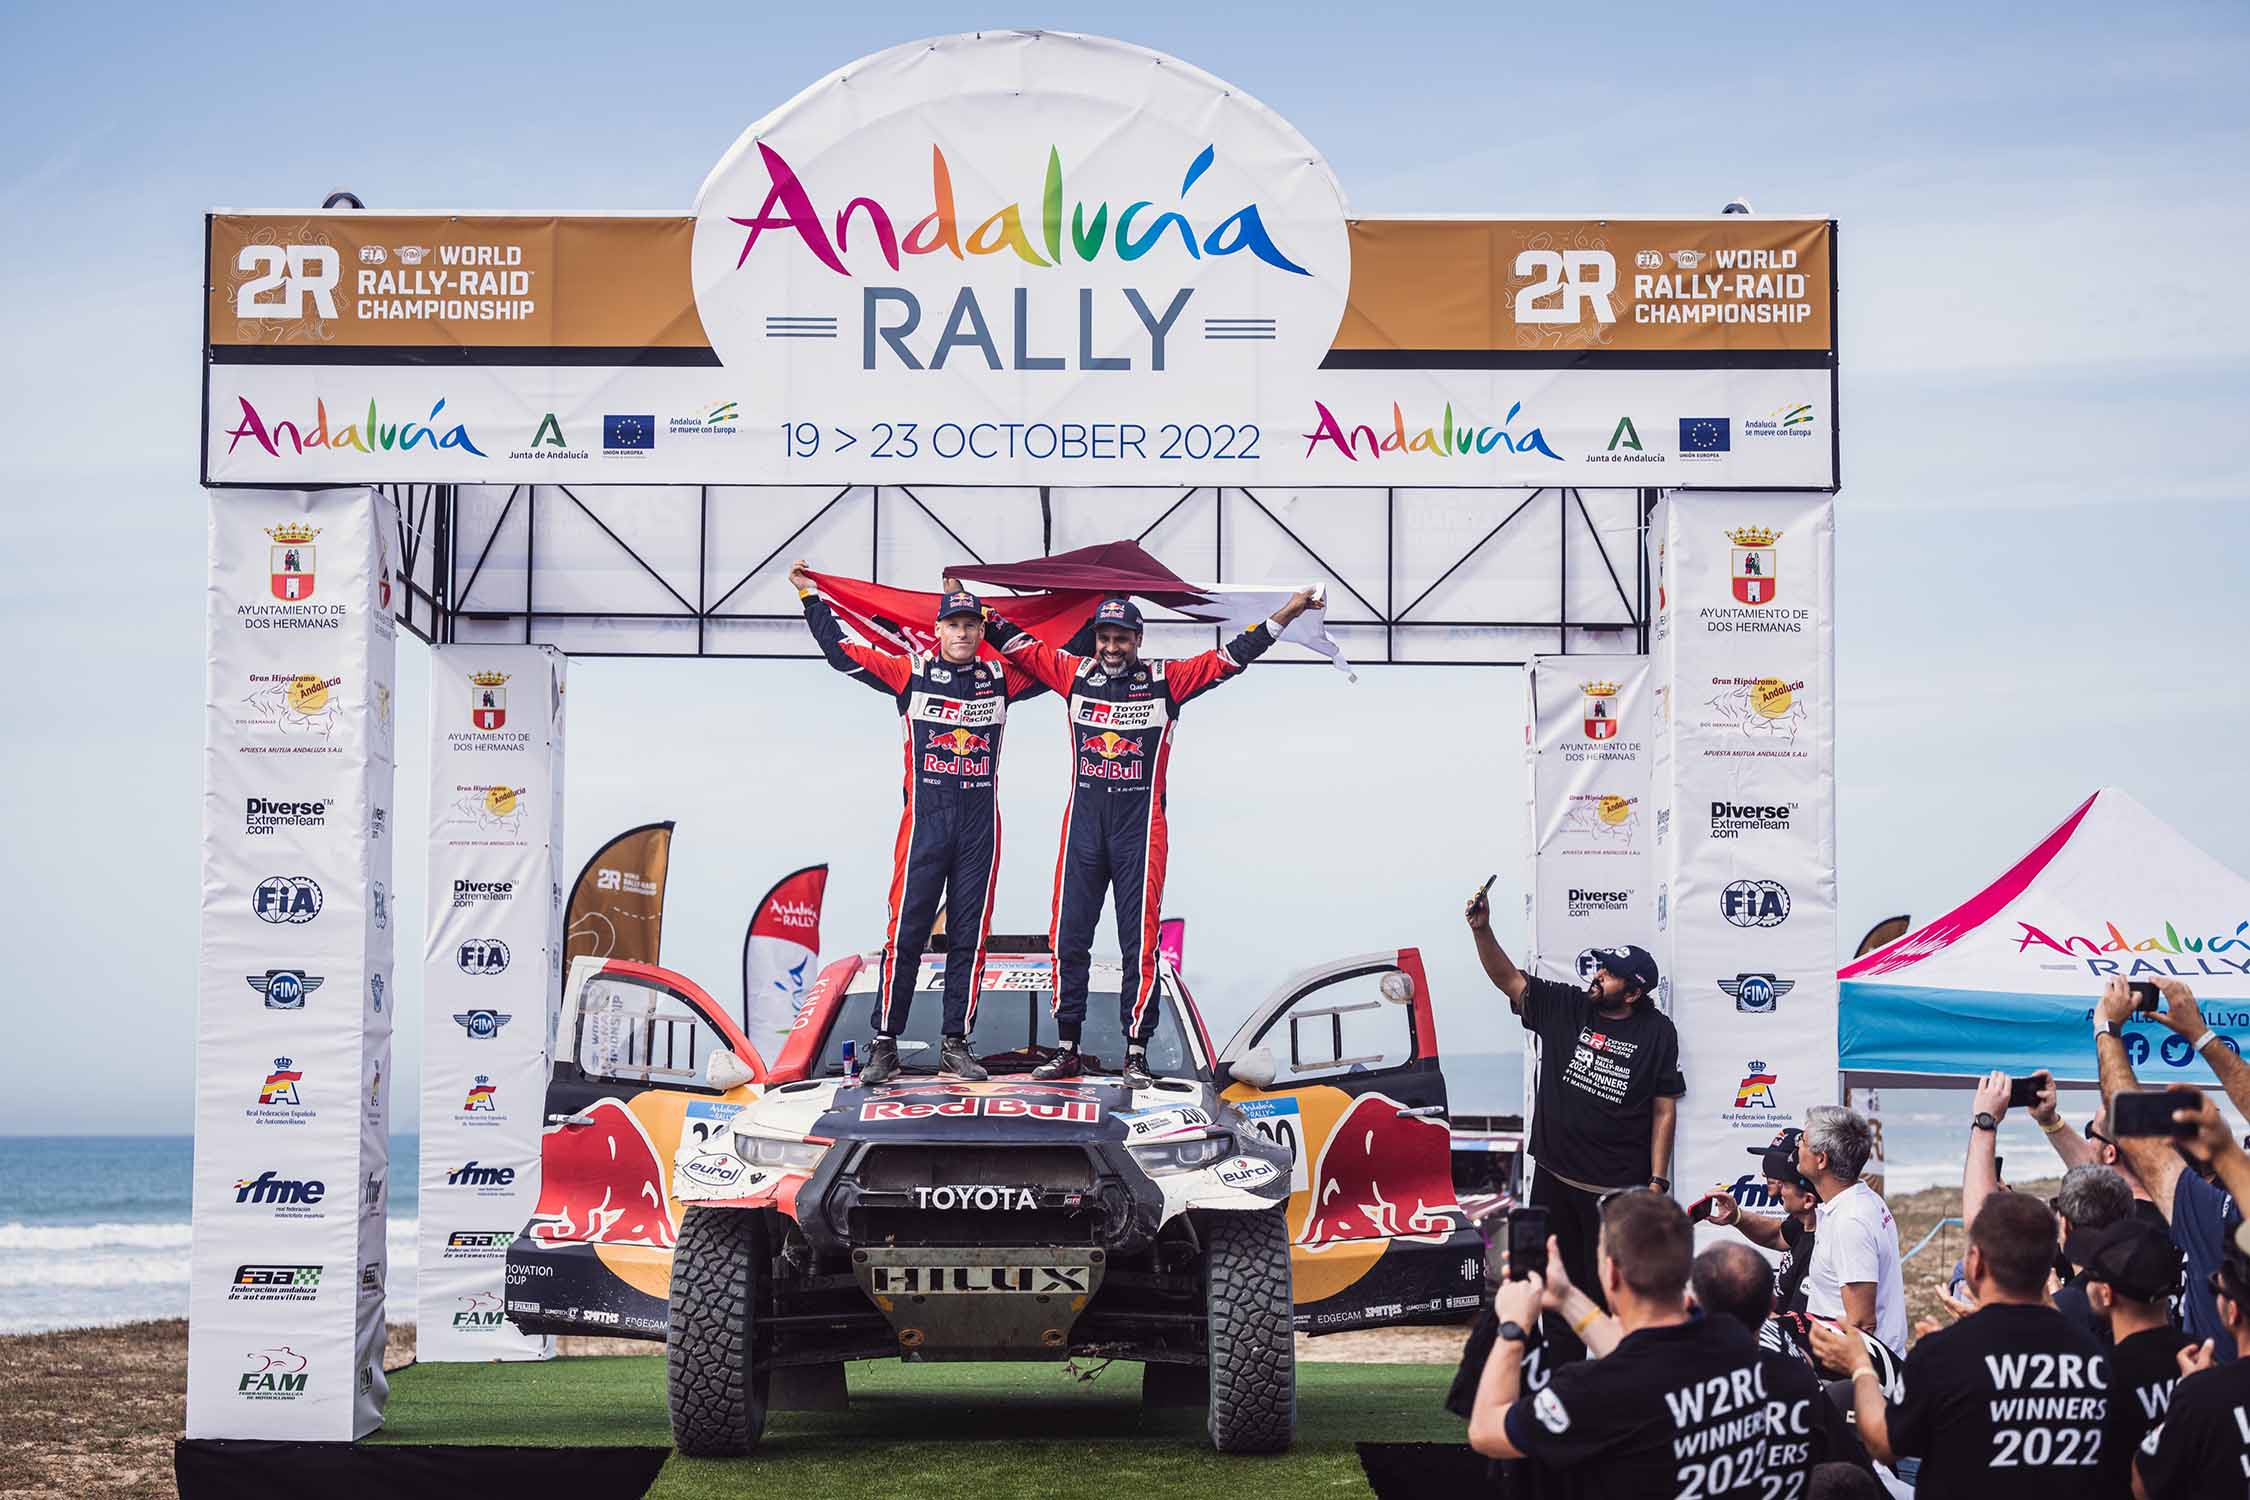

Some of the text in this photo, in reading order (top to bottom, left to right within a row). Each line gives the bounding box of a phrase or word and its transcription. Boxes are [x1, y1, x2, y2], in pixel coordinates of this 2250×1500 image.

[727, 140, 1315, 277] Andalucía
[440, 246, 522, 265] WORLD
[1715, 249, 1797, 269] WORLD
[237, 245, 340, 319] 2R
[358, 270, 530, 295] RALLY-RAID
[1515, 250, 1617, 324] 2R
[1634, 274, 1805, 299] RALLY-RAID
[358, 300, 535, 320] CHAMPIONSHIP
[1635, 304, 1812, 324] CHAMPIONSHIP
[863, 286, 1196, 371] RALLY
[225, 396, 488, 458] Andalucía
[713, 425, 736, 435] Europa
[1302, 400, 1566, 462] Andalucía
[1753, 429, 1775, 437] mueve
[1776, 429, 1788, 437] con
[1788, 428, 1811, 438] Europa
[780, 422, 820, 458] 19
[871, 422, 919, 458] 23
[932, 422, 1148, 460] OCTOBER
[1159, 423, 1261, 460] 2022
[509, 450, 589, 460] Junta de Andalucía
[1586, 453, 1665, 463] Junta de Andalucía
[237, 605, 346, 616] AYUNTAMIENTO DE
[1700, 608, 1808, 619] AYUNTAMIENTO DE
[245, 618, 339, 629] DOS HERMANAS
[1707, 621, 1801, 633] DOS HERMANAS
[963, 708, 994, 716] GAZOO
[965, 701, 996, 710] TOYOTA
[1114, 704, 1154, 712] TOYOTA
[962, 715, 992, 723] Racing
[1110, 718, 1147, 726] Racing
[1112, 711, 1149, 719] GAZOO
[448, 733, 530, 742] AYUNTAMIENTO DE
[453, 743, 525, 752] DOS HERMANAS
[1565, 752, 1636, 761] DOS HERMANAS
[923, 753, 990, 776] Red Bull
[1080, 757, 1142, 780] Red Bull
[247, 798, 325, 815] Diverse
[1711, 802, 1789, 819] Diverse
[247, 814, 324, 827] ExtremeTeam
[1711, 818, 1789, 830] ExtremeTeam
[245, 825, 274, 835] .com
[1710, 829, 1738, 838] .com
[454, 880, 512, 892] Diverse
[453, 891, 513, 901] ExtremeTeam
[1568, 889, 1627, 901] Diverse
[1567, 908, 1590, 917] .com
[1568, 901, 1628, 911] ExtremeTeam
[783, 915, 815, 928] RALLY
[2010, 920, 2250, 957] Andalucí
[272, 982, 298, 998] FIM
[1744, 986, 1769, 1001] FIM
[473, 1019, 492, 1031] FIM
[1595, 1059, 1631, 1075] RALLY-RAID
[1568, 1059, 1629, 1091] 2022 WINNERS
[1570, 1079, 1596, 1095] MATHIEU
[859, 1097, 1100, 1124] Red Bull
[689, 1163, 739, 1181] eurol
[1223, 1164, 1273, 1182] eurol
[235, 1171, 325, 1204] rfme
[915, 1186, 1038, 1211] TOYOTA
[504, 1275, 527, 1285] OUP
[873, 1267, 1088, 1292] HILUX
[452, 1312, 505, 1325] FAM
[583, 1309, 620, 1324] SMITHS
[625, 1316, 668, 1329] EDGECAM
[1317, 1311, 1361, 1324] EDGECAM
[1984, 1354, 2108, 1390] W2RC
[238, 1373, 309, 1391] FAM
[1989, 1399, 2106, 1423] WINNERS
[1988, 1428, 2102, 1467] 2022
